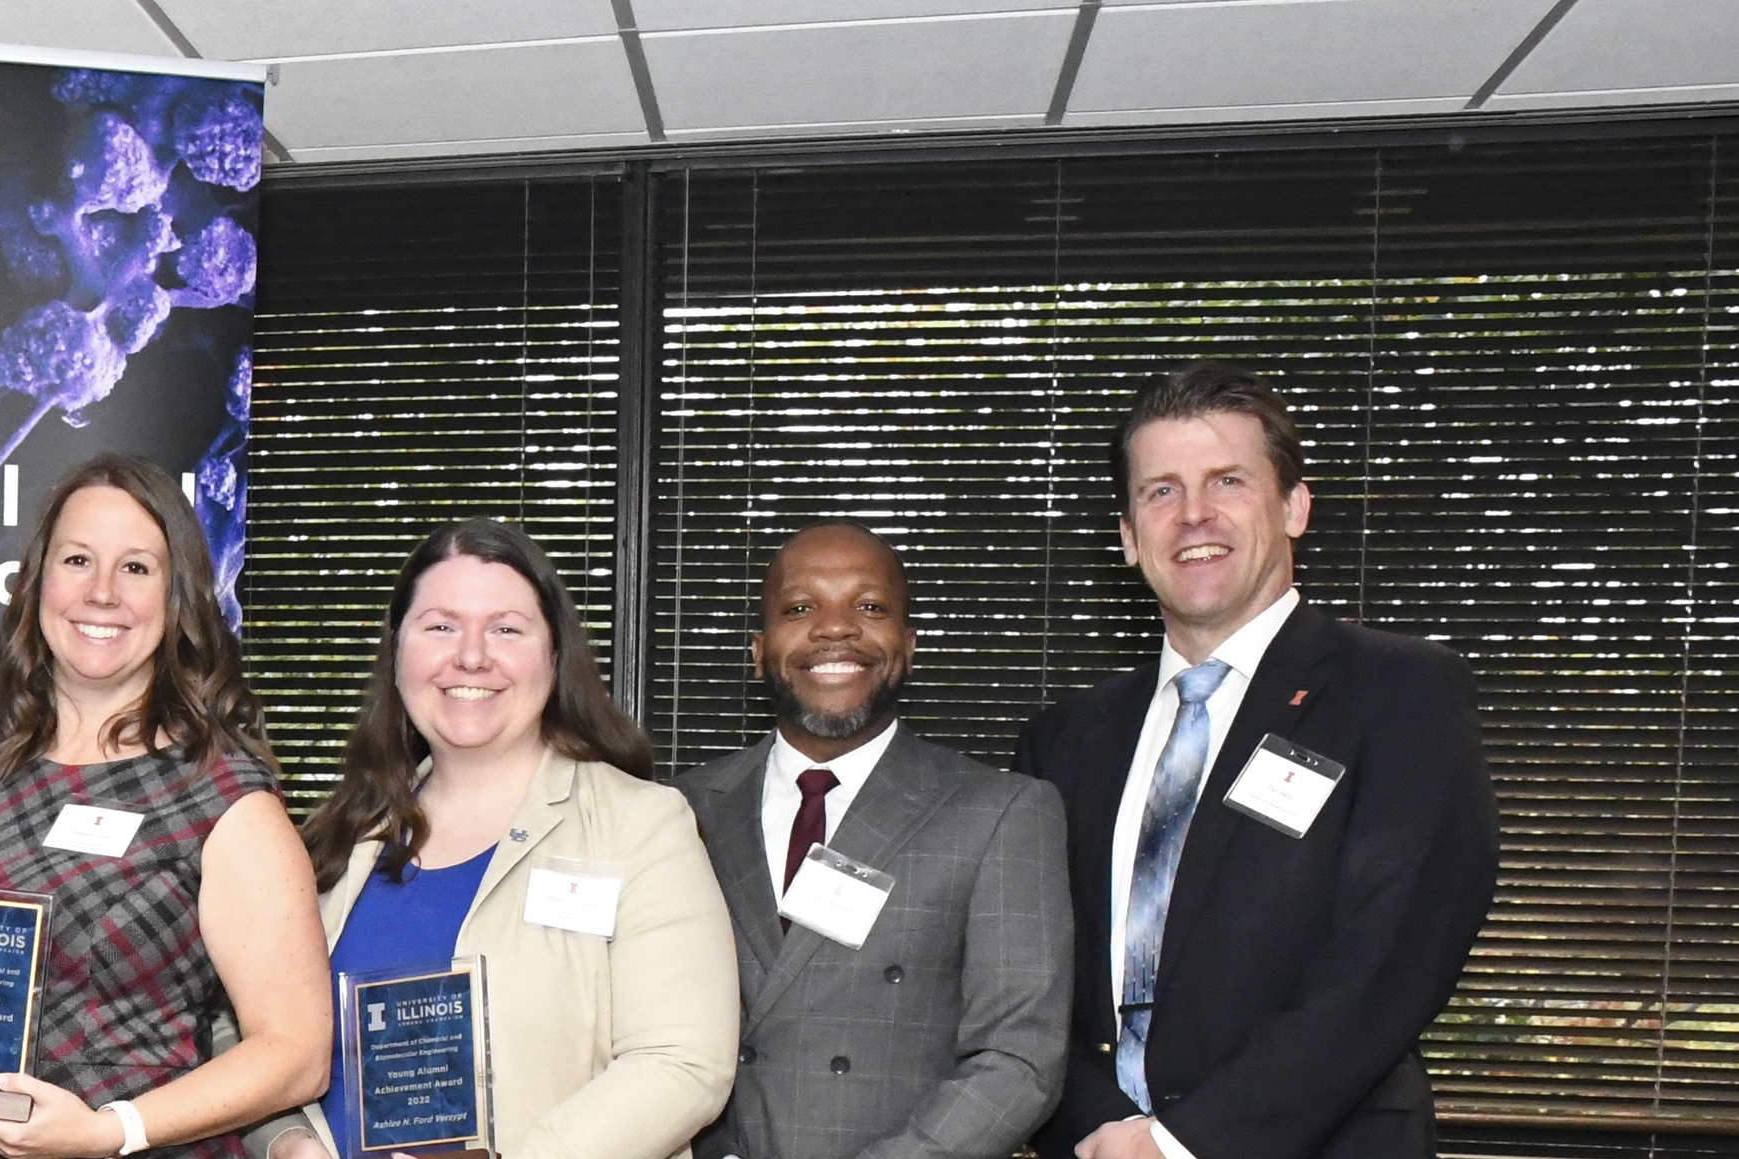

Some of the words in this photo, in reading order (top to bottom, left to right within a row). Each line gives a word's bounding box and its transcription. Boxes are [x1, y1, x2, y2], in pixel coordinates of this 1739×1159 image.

[397, 1001, 462, 1020] ILLINOIS
[387, 1070, 415, 1079] Young
[417, 1064, 448, 1075] Alumni
[375, 1082, 432, 1095] Achievement
[434, 1077, 463, 1087] Award
[408, 1096, 430, 1105] 2022
